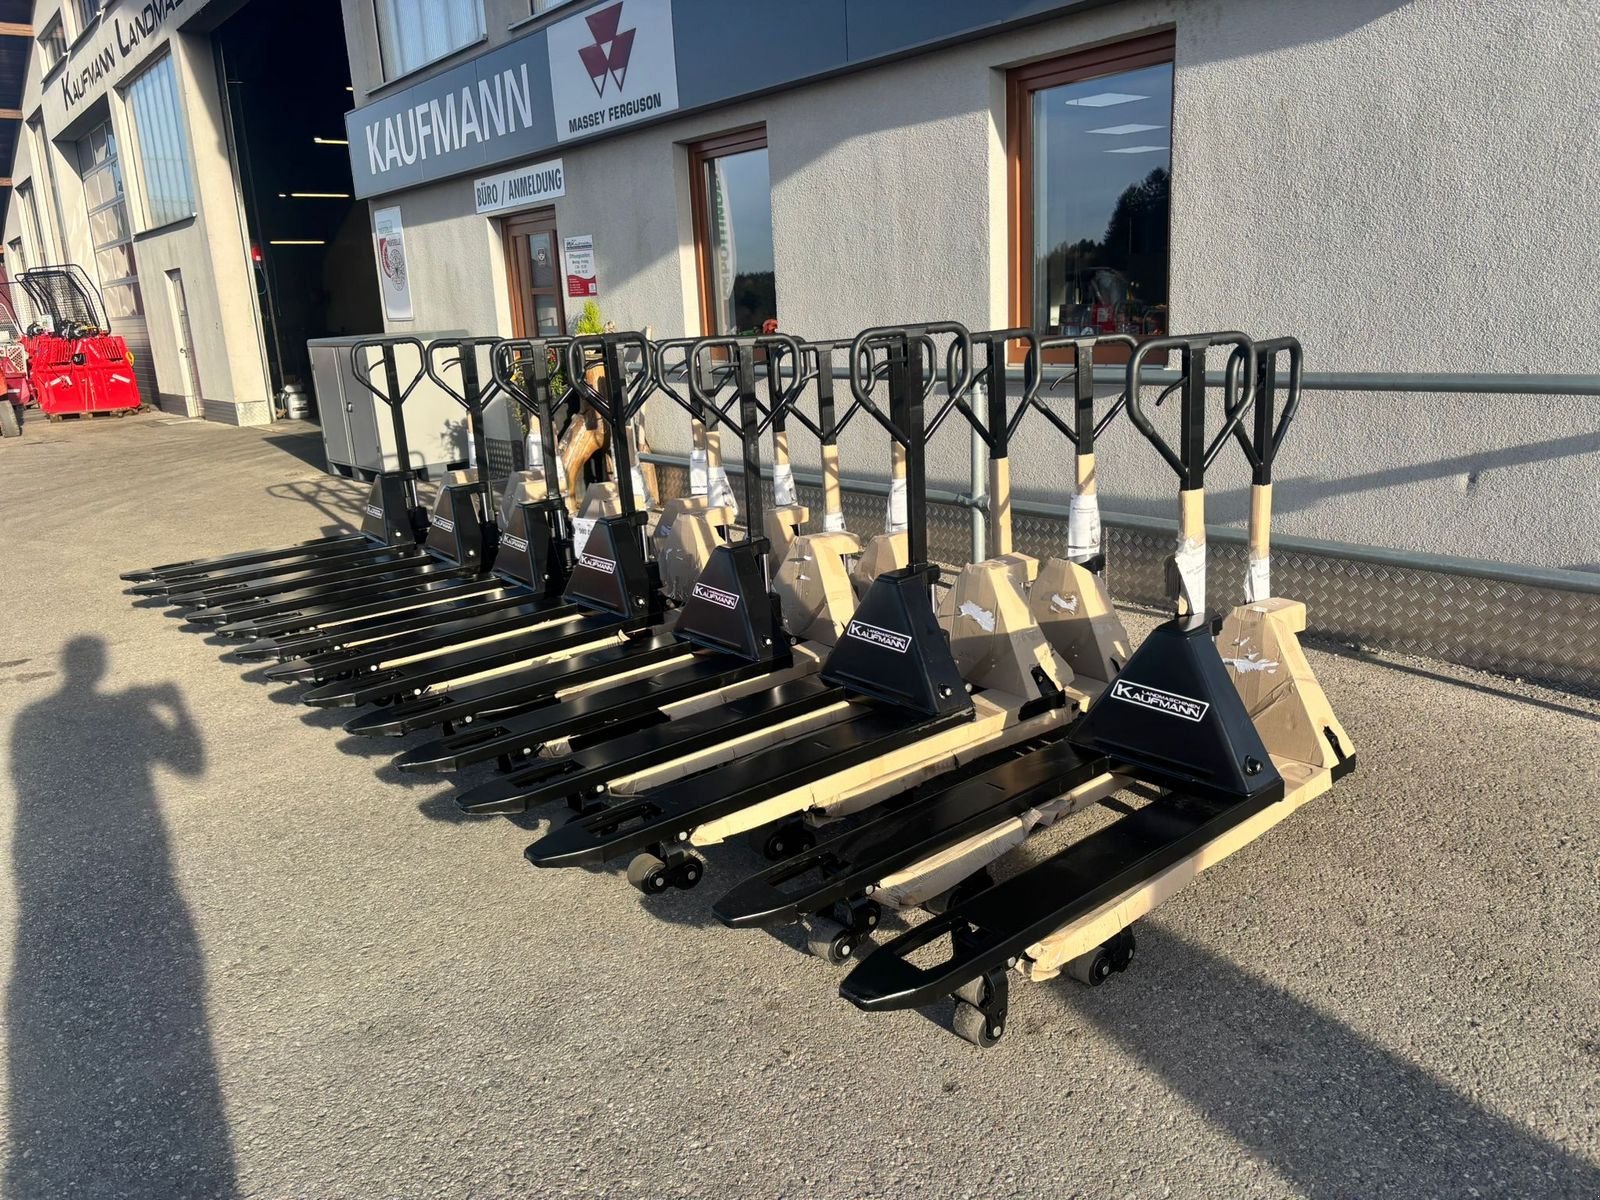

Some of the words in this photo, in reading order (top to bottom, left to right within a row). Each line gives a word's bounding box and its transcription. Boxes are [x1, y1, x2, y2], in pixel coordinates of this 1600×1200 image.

[61, 42, 115, 111] KAUFMANN
[365, 63, 533, 175] KAUFMANN
[569, 110, 605, 133] MASSEY
[608, 92, 662, 121] FERGUSON
[476, 181, 498, 207] BÜRO
[508, 168, 562, 200] ANMELDUNG
[581, 555, 613, 571] KAUFMANN
[695, 585, 735, 606] KAUFMANN
[851, 624, 906, 649] KAUFMANN
[1117, 683, 1200, 718] KAUFMANN
[1141, 690, 1200, 710] LANDMASCHINEN
